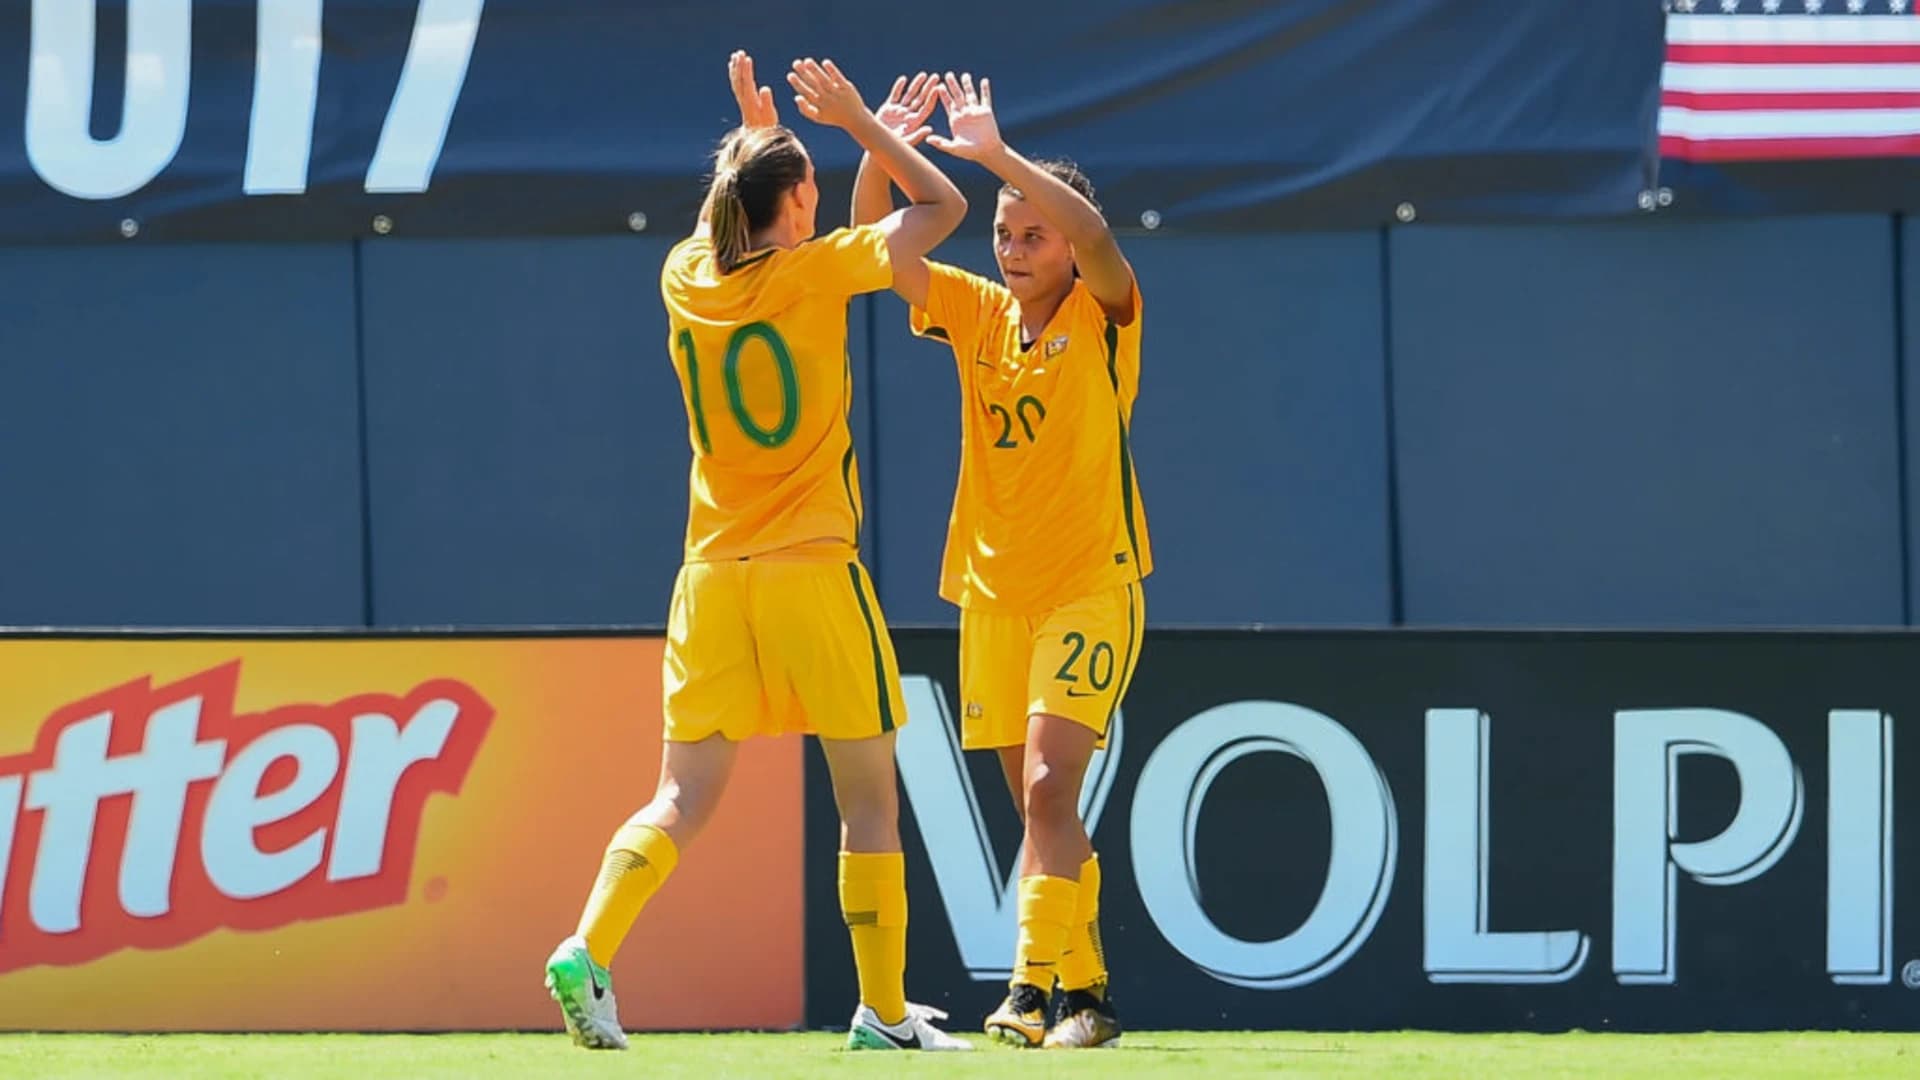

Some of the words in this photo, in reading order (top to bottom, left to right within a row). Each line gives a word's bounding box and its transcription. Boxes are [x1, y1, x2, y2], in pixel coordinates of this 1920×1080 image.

[679, 320, 798, 456] 10
[990, 394, 1046, 449] 20
[1055, 631, 1115, 691] 20
[0, 696, 460, 933] tter
[895, 675, 1893, 990] VOLPI
